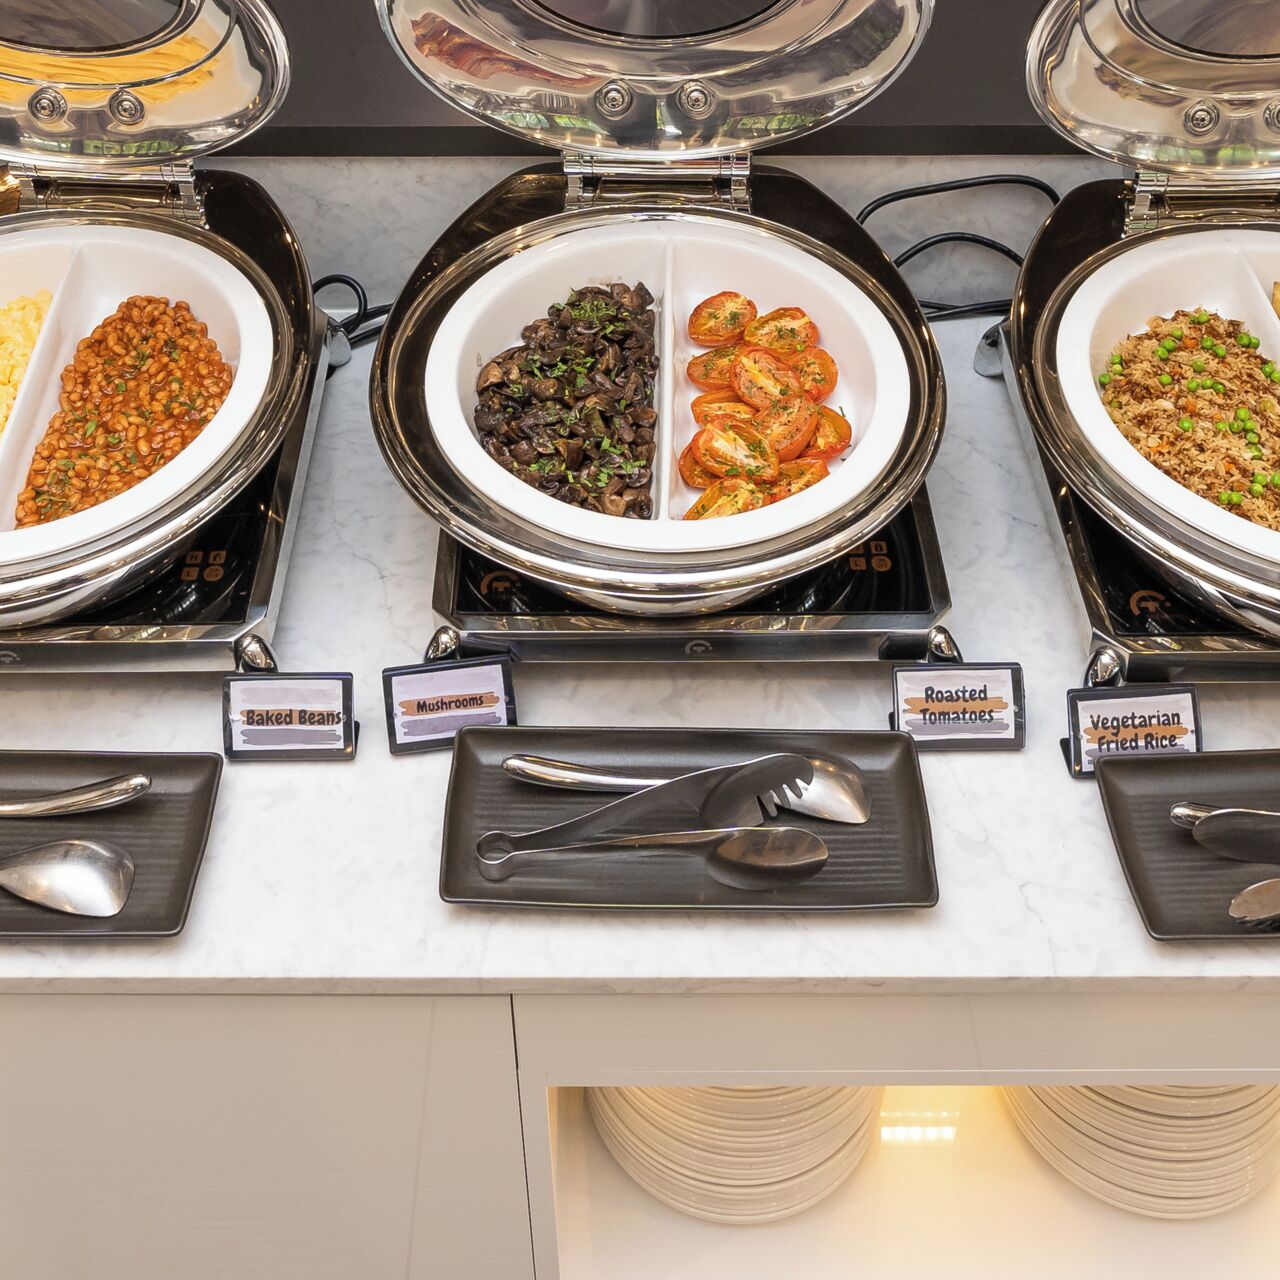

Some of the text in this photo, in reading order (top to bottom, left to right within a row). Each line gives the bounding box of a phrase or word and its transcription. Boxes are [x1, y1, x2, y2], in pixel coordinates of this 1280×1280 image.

[415, 693, 484, 713] Mushrooms
[924, 685, 988, 704] Roasted
[246, 709, 341, 726] Baked Beans
[919, 707, 994, 724] Tomatoes
[1089, 712, 1181, 736] Vegetarian
[1097, 732, 1178, 752] Fried Rice
